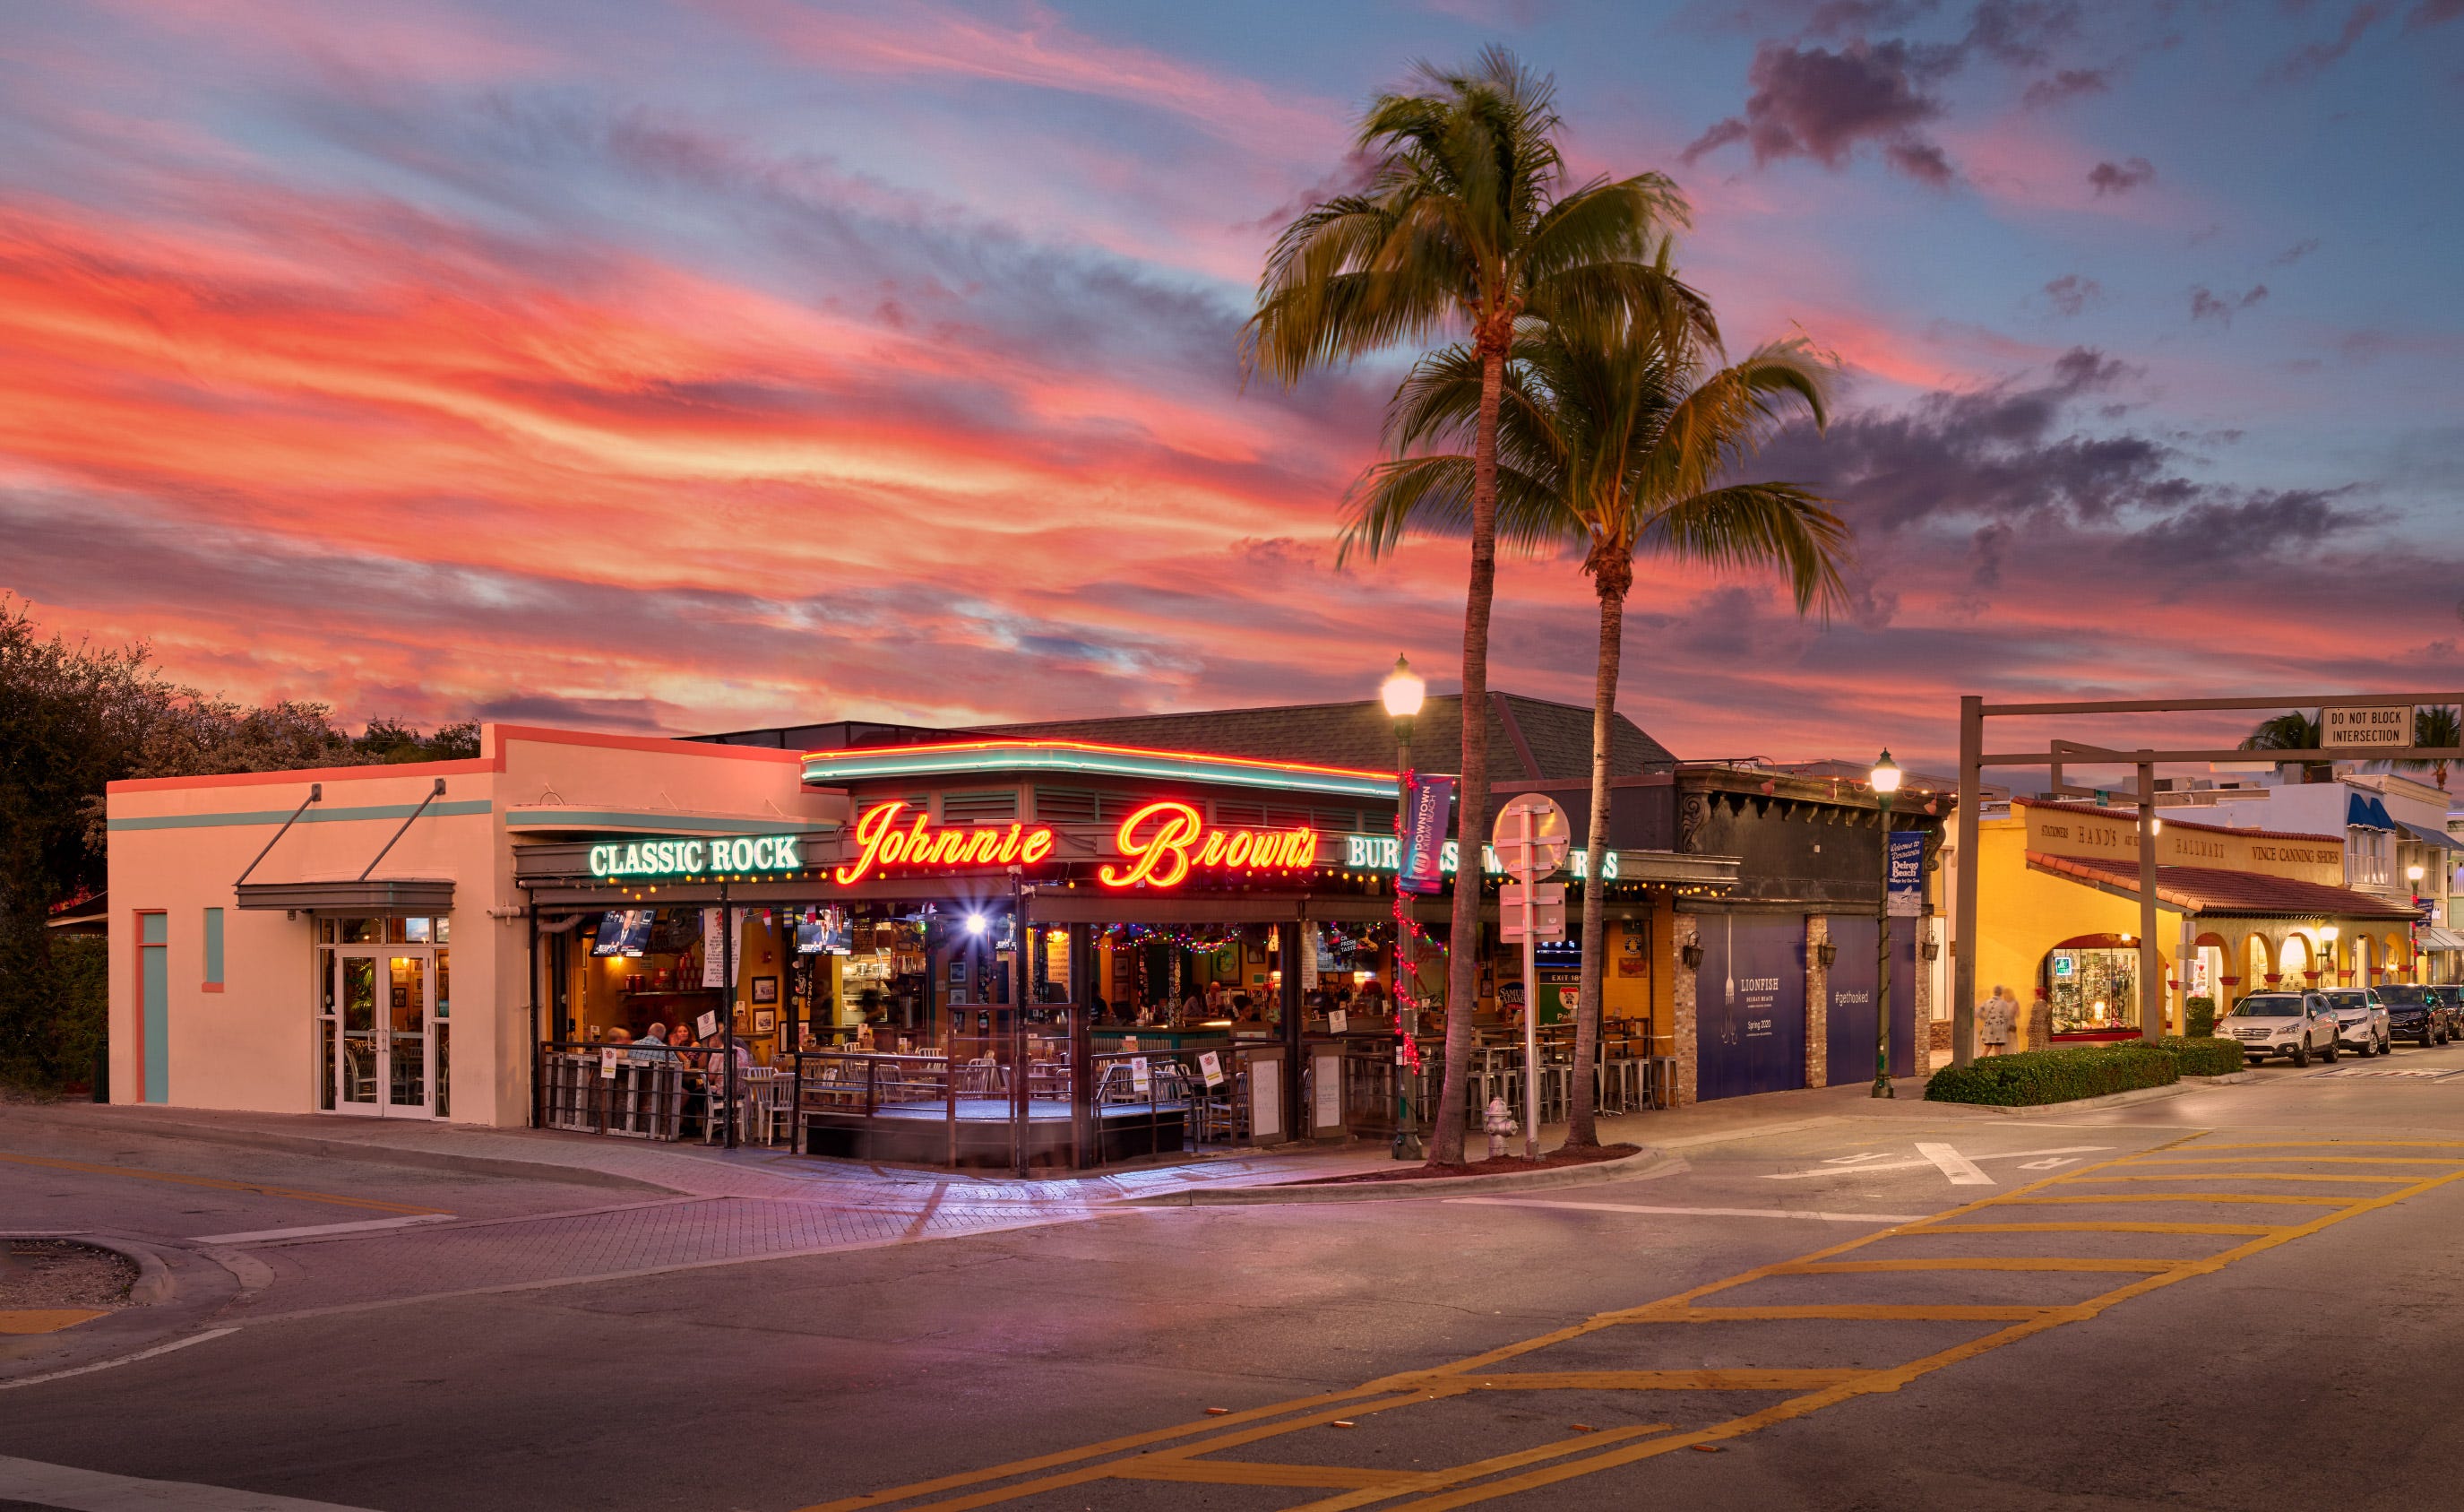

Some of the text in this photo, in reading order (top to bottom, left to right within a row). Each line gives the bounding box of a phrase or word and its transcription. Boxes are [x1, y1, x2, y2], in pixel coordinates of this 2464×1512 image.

[2331, 712, 2401, 724] DO NOT BLOCK
[2333, 730, 2399, 741] INTERSECTION
[2041, 825, 2069, 839] STATIONERS
[2078, 825, 2116, 846] HAND'S
[836, 801, 1319, 887] Johnnie Brown's
[2175, 839, 2224, 858] HALLMARK
[590, 836, 799, 876] CLASSIC ROCK
[2252, 846, 2339, 865] VINCE CANNING SHOES
[1892, 861, 1918, 869] Delray
[1892, 868, 1917, 878] Beach
[1741, 978, 1779, 991] LIONFISH
[1835, 990, 1868, 1006] #gethooked
[1747, 1019, 1770, 1031] Spring 2020
